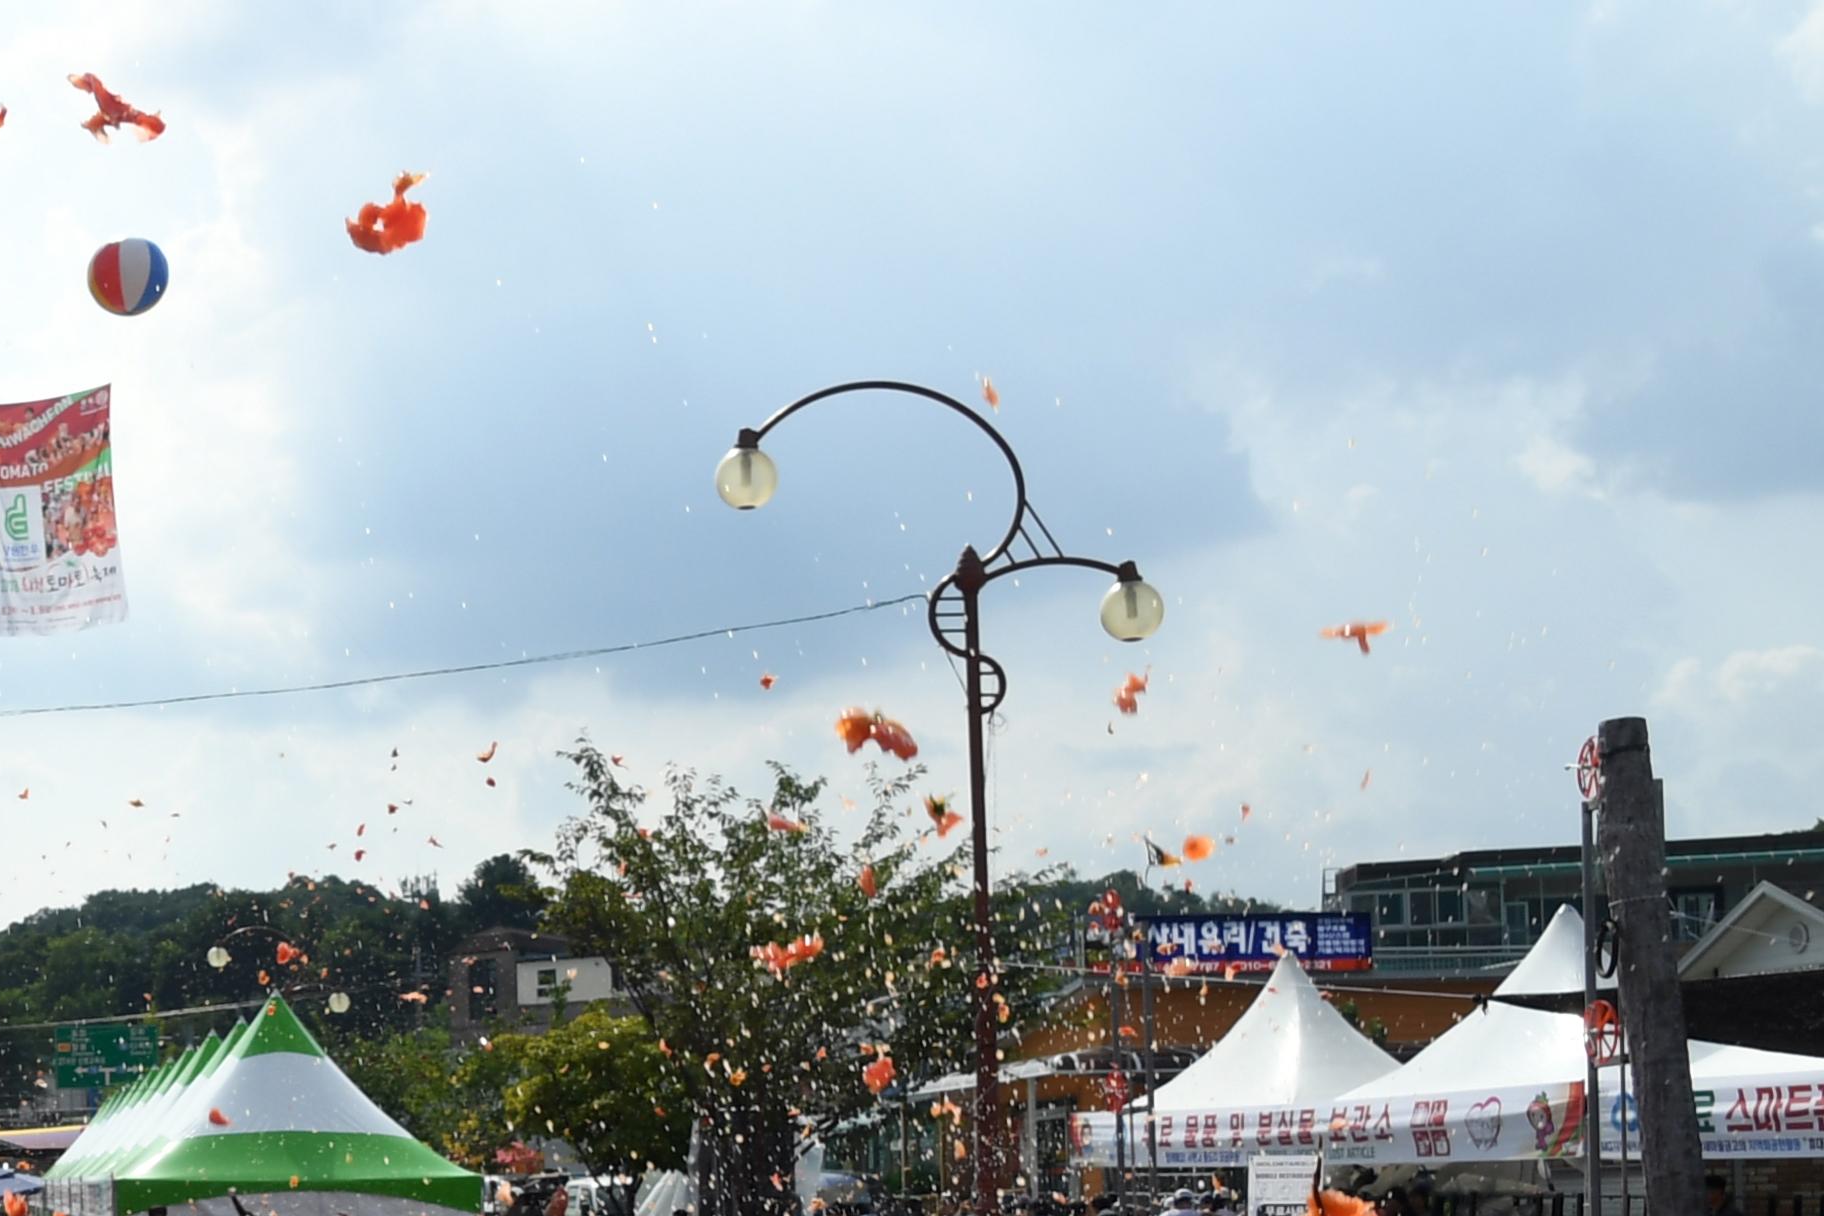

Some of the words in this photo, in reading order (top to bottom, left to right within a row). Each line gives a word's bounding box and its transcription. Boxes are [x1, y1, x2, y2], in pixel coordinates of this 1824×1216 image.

[0, 395, 73, 449] HWACHEON
[46, 568, 86, 593] 토마토
[1142, 1114, 1174, 1148] 료
[1183, 1113, 1218, 1149] 물품
[1229, 1113, 1245, 1148] 및
[1256, 1108, 1316, 1147] 분실물
[1329, 1103, 1394, 1143] 보관소
